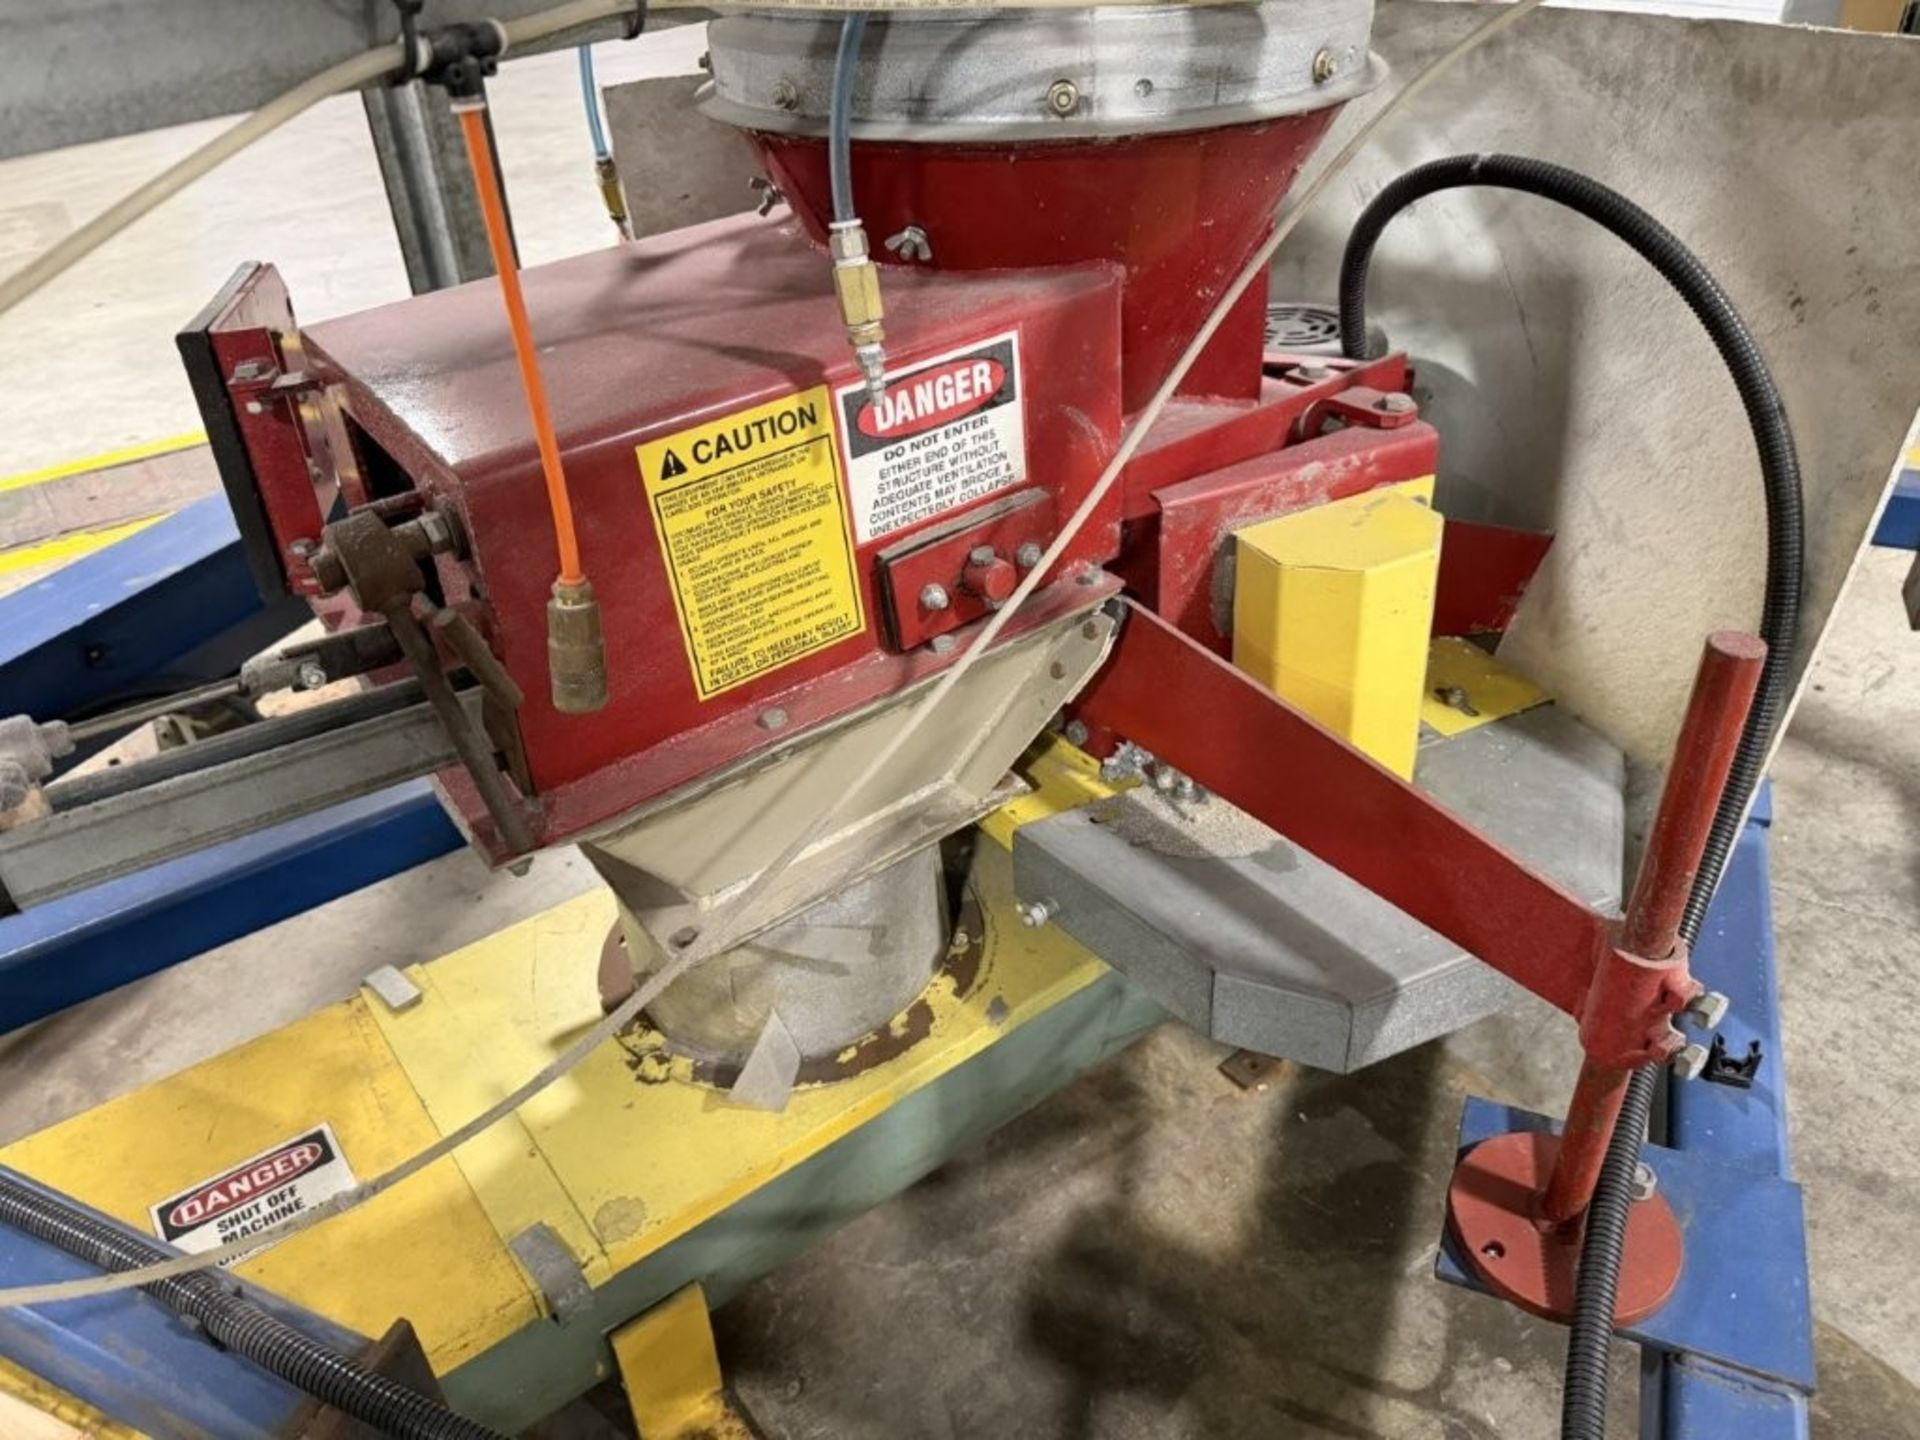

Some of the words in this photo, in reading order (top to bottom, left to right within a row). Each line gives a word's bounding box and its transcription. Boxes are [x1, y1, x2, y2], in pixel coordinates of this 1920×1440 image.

[873, 361, 993, 432] DANGER
[692, 403, 817, 464] CAUTION
[879, 457, 922, 480] EITHER
[925, 446, 949, 464] END
[953, 439, 968, 453] OF
[971, 429, 997, 446] THIS
[884, 446, 905, 462] DO
[910, 434, 940, 453] NOT
[945, 415, 989, 440] ENTER
[872, 480, 932, 510] ADEQUATE
[937, 452, 1008, 484] VENTILATION
[877, 463, 946, 494] STRUCTURE
[949, 440, 1000, 467] WITHOUT
[704, 502, 728, 519] FOR
[729, 491, 757, 510] YOUR
[758, 477, 797, 500] SAFETY
[868, 499, 956, 538] UNEXPECTEDLY
[869, 493, 931, 524] CONTENTS
[934, 484, 957, 500] MAY
[961, 469, 1000, 490] BRIDGE
[178, 1144, 315, 1224] DANGER
[217, 1203, 261, 1233] SHUT
[267, 1185, 298, 1208] OFF
[222, 1197, 306, 1244] MACHINE
